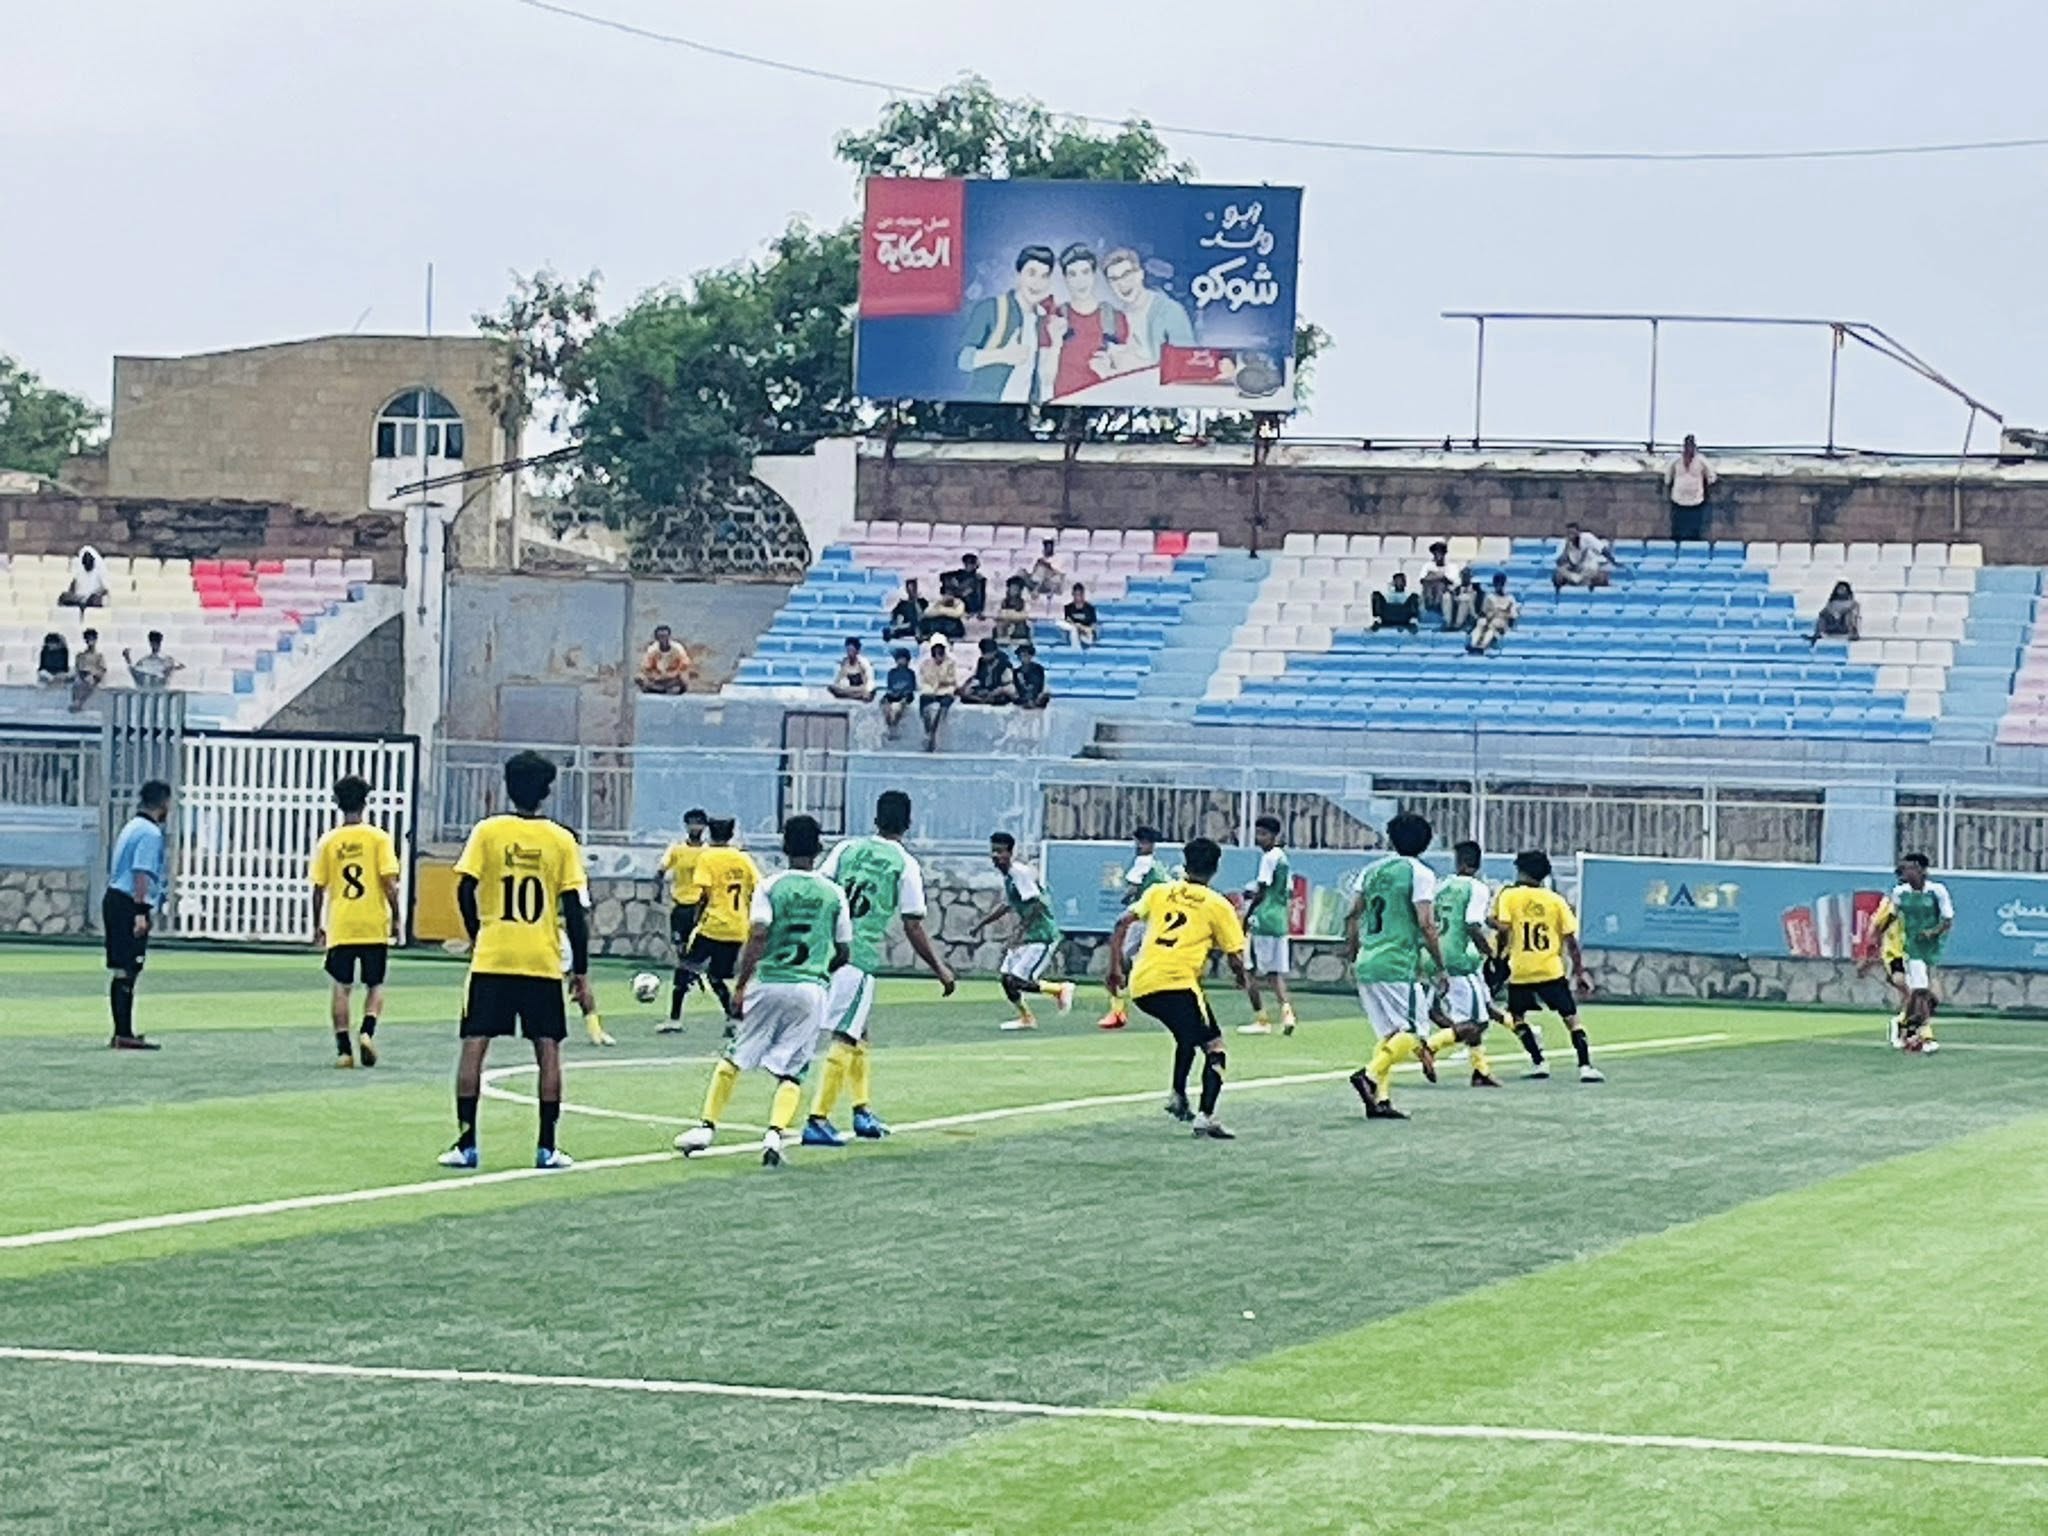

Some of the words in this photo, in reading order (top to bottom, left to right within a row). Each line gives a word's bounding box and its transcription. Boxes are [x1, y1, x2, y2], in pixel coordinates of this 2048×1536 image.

[1191, 255, 1279, 312] شوكو
[342, 863, 365, 900] 8
[500, 874, 545, 925] 10
[727, 883, 742, 911] 7
[776, 922, 812, 967] 5
[1155, 910, 1188, 948] 2
[1522, 921, 1550, 952] 16
